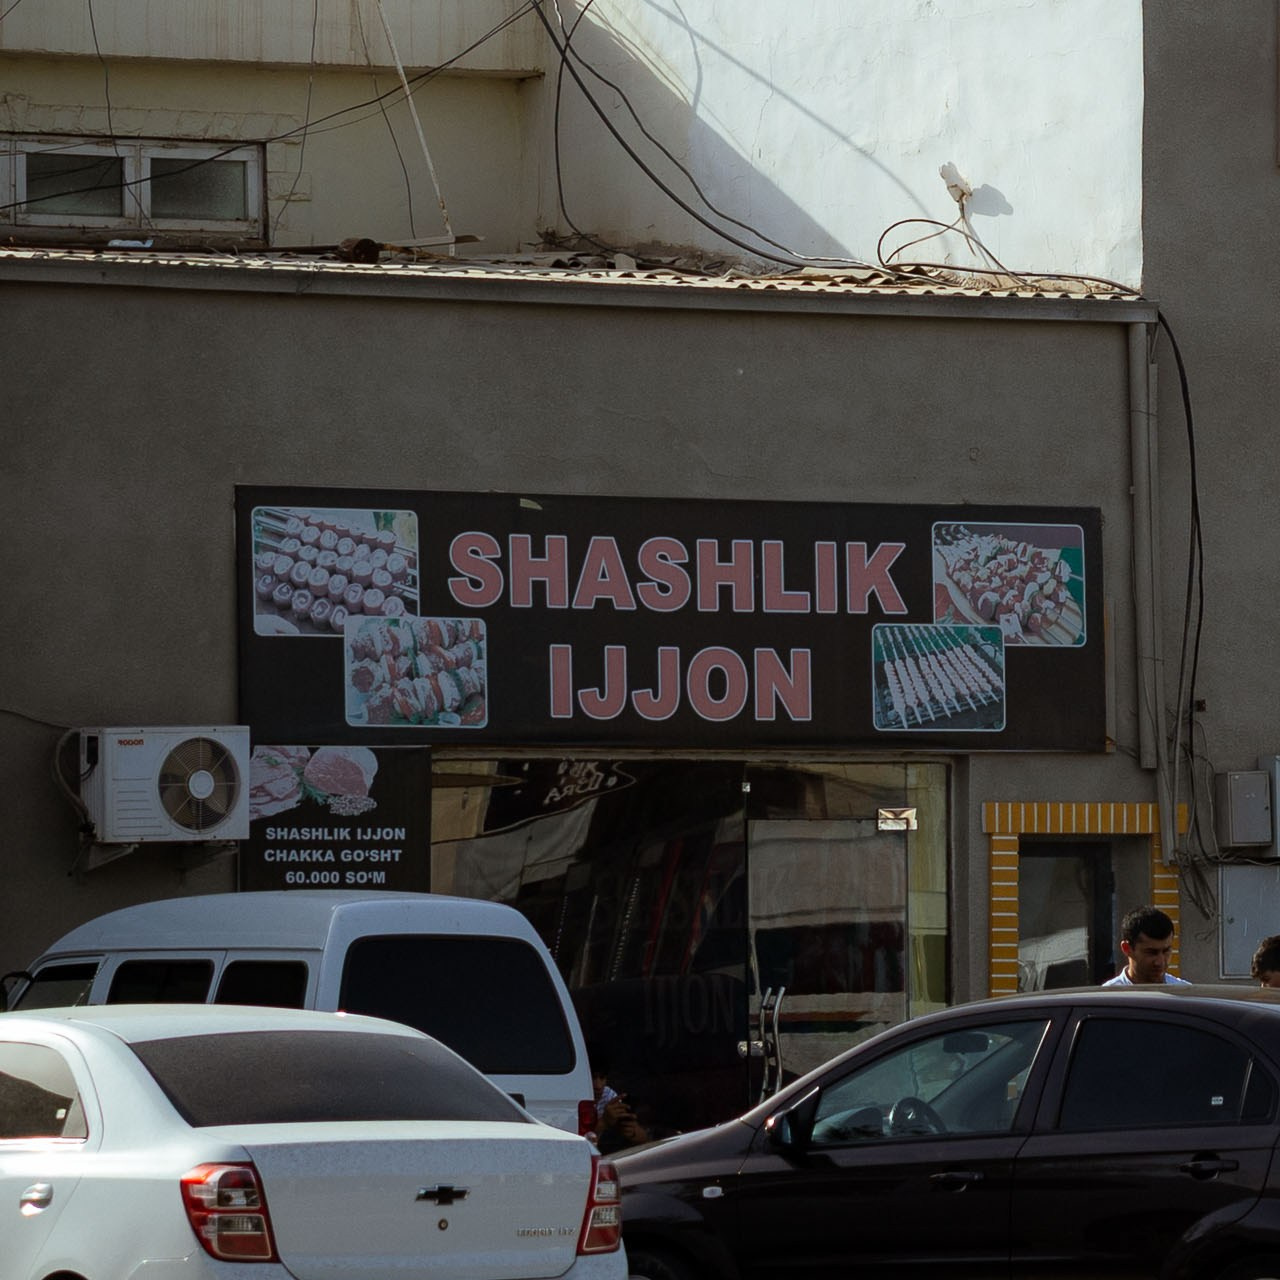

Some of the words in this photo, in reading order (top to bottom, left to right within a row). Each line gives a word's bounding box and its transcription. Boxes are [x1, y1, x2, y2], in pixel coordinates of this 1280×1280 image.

[446, 531, 908, 616] SHASHLIK
[548, 643, 813, 723] IJJON
[265, 827, 351, 841] SHASHLIK
[357, 827, 406, 840] IJJON
[264, 849, 335, 862] CHAKKA
[285, 871, 340, 884] 60.000
